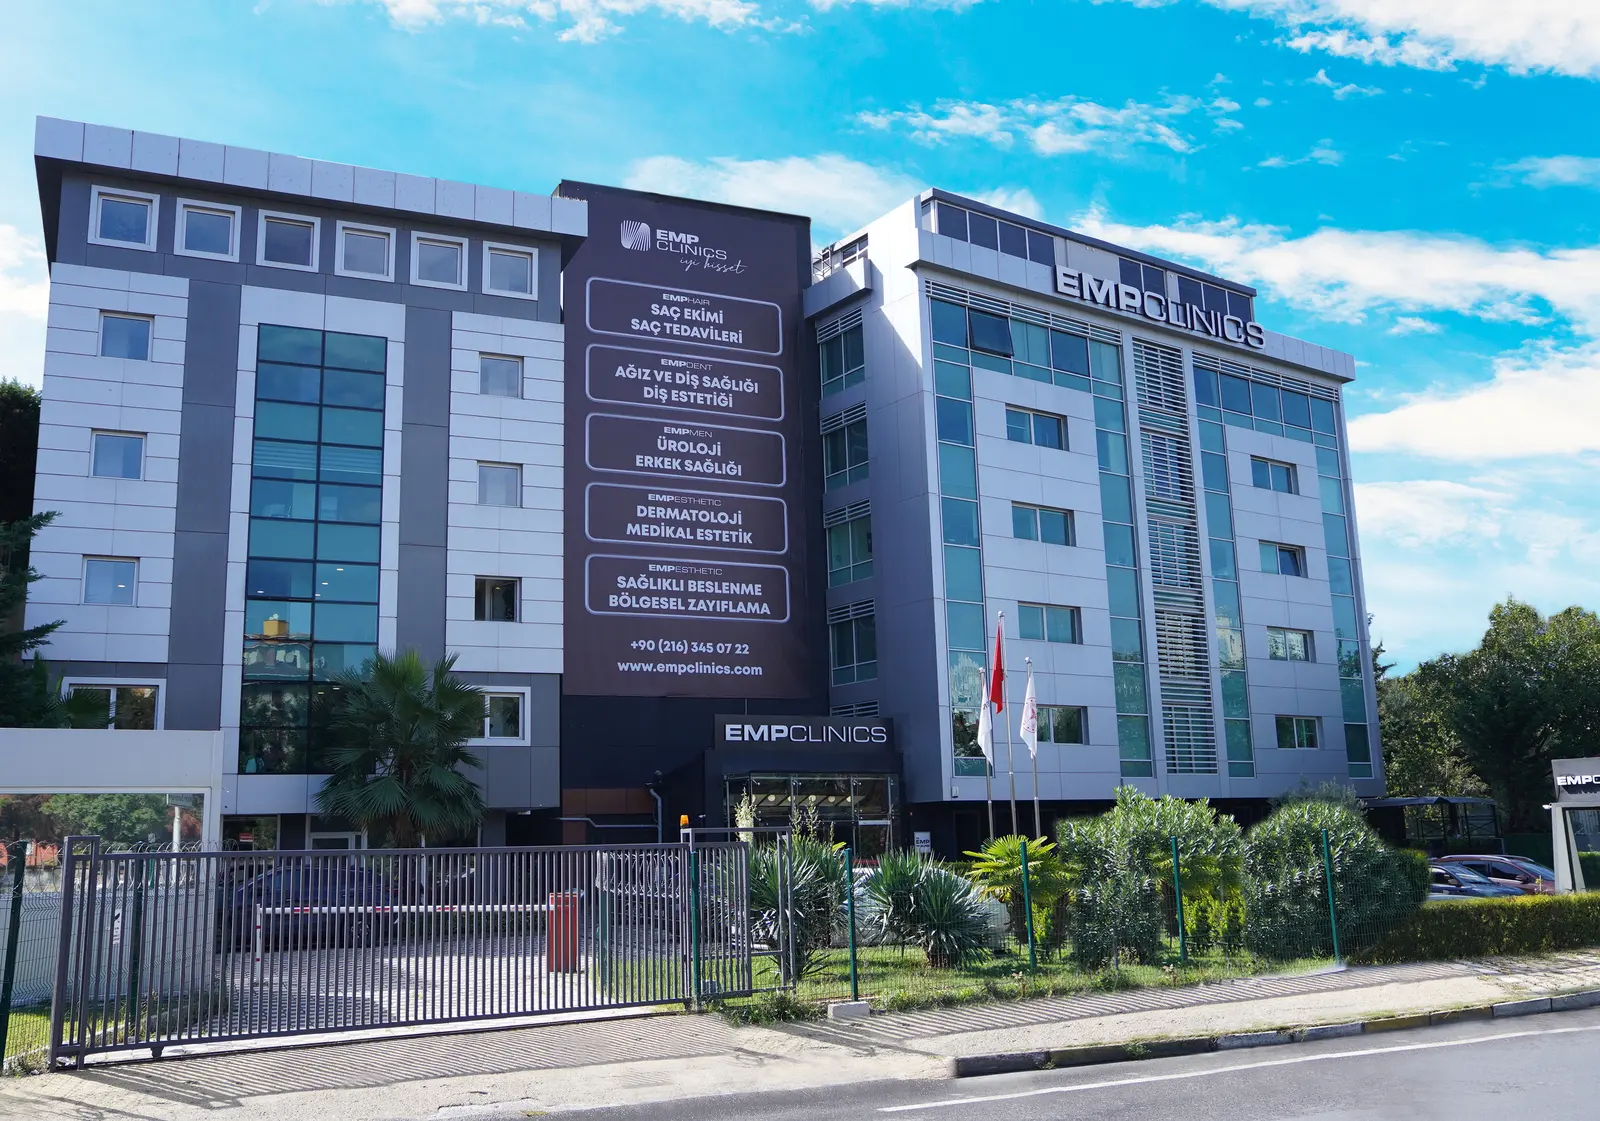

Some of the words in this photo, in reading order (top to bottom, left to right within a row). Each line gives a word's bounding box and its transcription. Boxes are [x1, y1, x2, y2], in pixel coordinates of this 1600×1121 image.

[656, 229, 699, 244] EMP
[656, 240, 727, 260] CLINICS
[662, 293, 710, 306] EMPHAIR
[1055, 264, 1266, 349] EMPCLINICS
[651, 304, 680, 321] SAÇ
[684, 307, 724, 324] EKİMİ
[631, 318, 661, 335] SAÇ
[663, 322, 743, 343] TEDAVİLERİ
[661, 358, 713, 371] EMPDENT
[614, 364, 651, 381] AĞIZ
[653, 370, 672, 383] VE
[675, 370, 700, 390] DİŞ
[702, 375, 759, 394] SAĞLIĞI
[643, 384, 668, 404] DİŞ
[671, 389, 733, 408] ESTETİĞİ
[663, 426, 713, 438] EMPMEN
[657, 435, 722, 456] ÜROLOJİ
[635, 454, 682, 471] ERKEK
[684, 458, 742, 476] SAĞLIĞI
[648, 493, 722, 507] EMPESTHETIC
[636, 505, 742, 525] DERMATOLOJİ
[626, 522, 694, 540] MEDİKAL
[696, 528, 753, 544] ESTETİK
[648, 564, 723, 576] EMPESTHETIC
[617, 574, 684, 592] SAĞLIKLI
[687, 580, 762, 596] BESLENME
[609, 592, 686, 611] BÖLGESEL
[687, 599, 771, 615] ZAYIFLAMA
[630, 639, 655, 651] +90
[658, 638, 688, 654] (216)
[691, 641, 713, 653] 345
[716, 642, 732, 654] 07
[735, 643, 750, 655] 22
[617, 661, 763, 676] www.empclinics.com
[725, 724, 887, 743] EMPCLINICS
